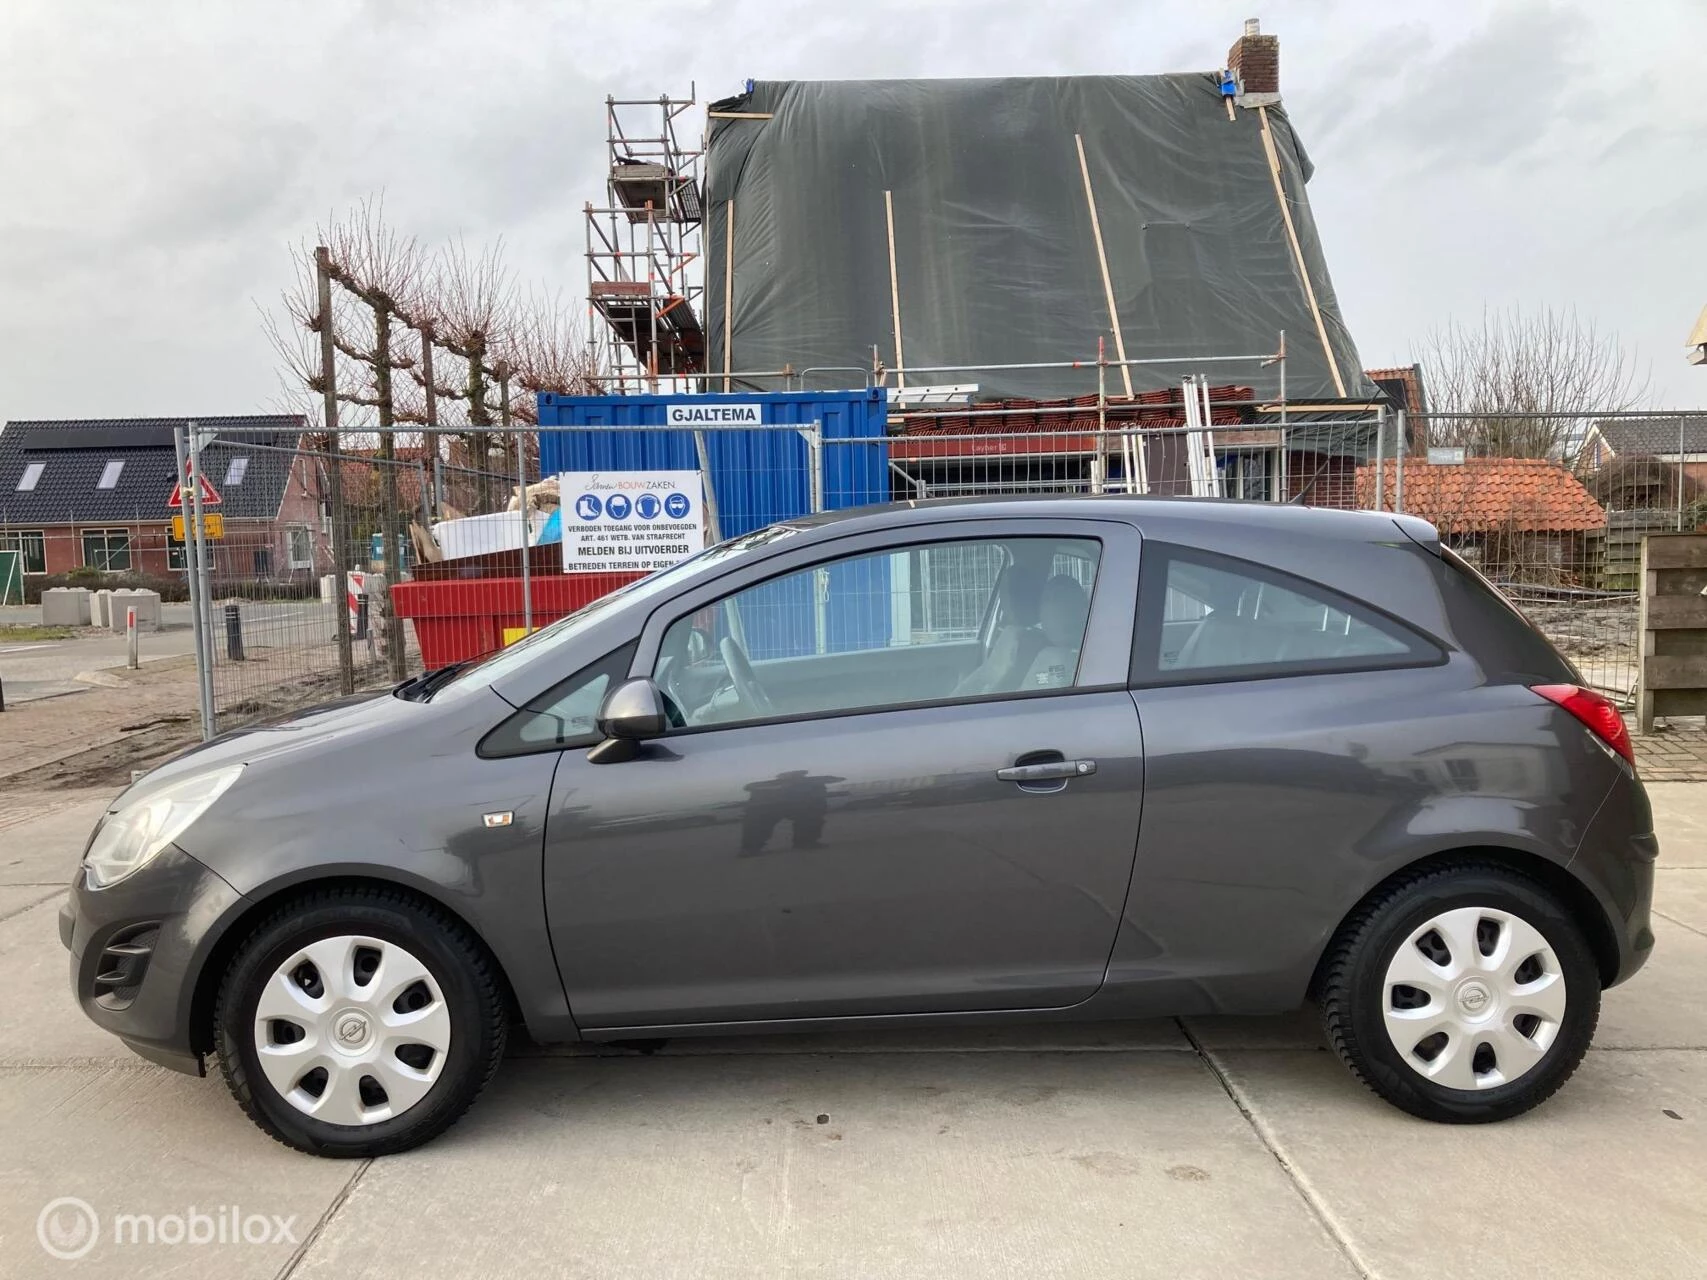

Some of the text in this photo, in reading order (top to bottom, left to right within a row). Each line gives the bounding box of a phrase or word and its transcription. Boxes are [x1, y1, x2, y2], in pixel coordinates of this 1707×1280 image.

[672, 408, 757, 422] GJALTEMA
[603, 524, 633, 532] TOEGANG
[633, 523, 651, 531] VOOR
[646, 532, 685, 540] STRAFRECHT
[577, 545, 689, 556] MELDEN BIJ UITVOERDER
[568, 562, 607, 571] BETREDEN
[608, 562, 639, 570] TERREIN
[641, 561, 652, 569] OP
